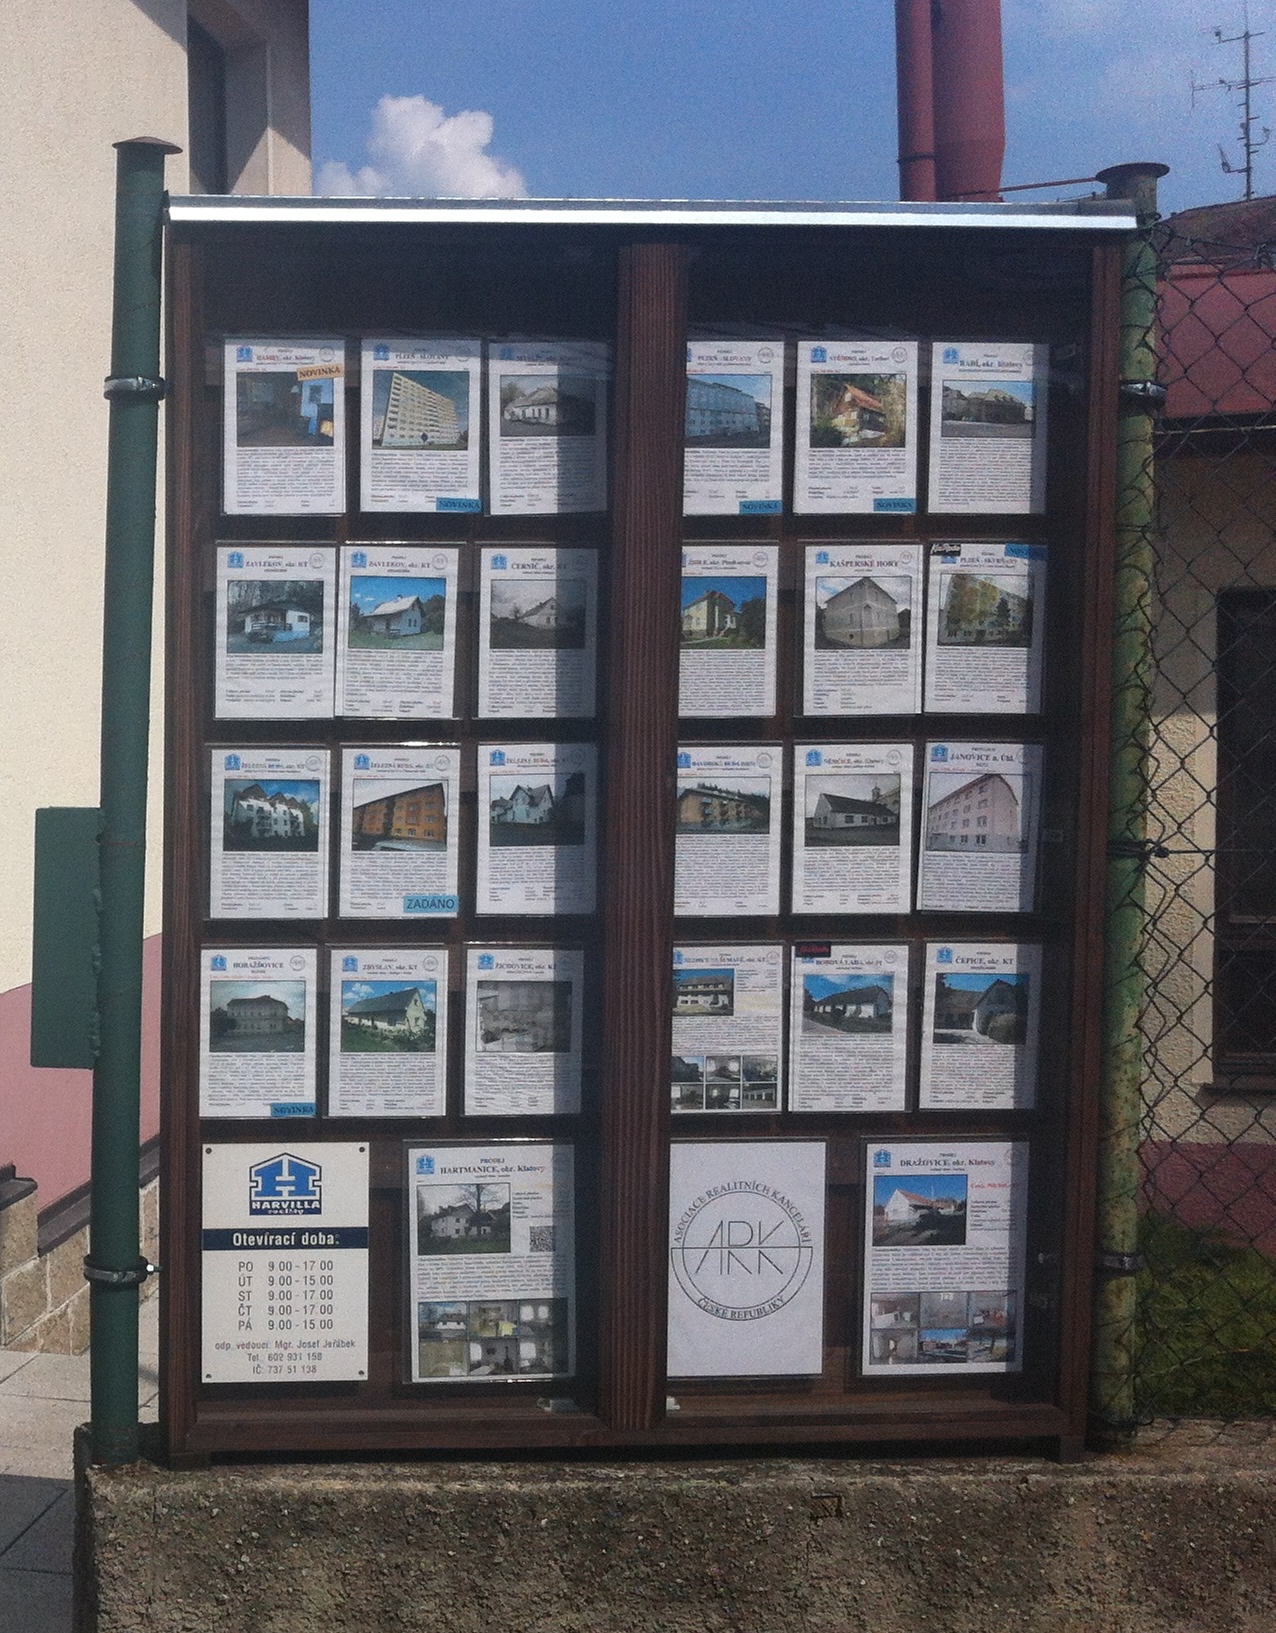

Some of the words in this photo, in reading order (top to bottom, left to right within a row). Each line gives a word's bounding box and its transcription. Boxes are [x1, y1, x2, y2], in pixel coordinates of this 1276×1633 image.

[298, 366, 341, 378] NOVINKA
[438, 500, 481, 509] NOVINKA
[829, 559, 875, 568] KAŠPERSKÉ
[273, 1106, 314, 1115] NOVINKA
[900, 1158, 950, 1167] DRAŽOVICE,
[952, 1159, 966, 1167] okr.
[440, 1166, 500, 1174] HARTMANICE,
[517, 1165, 545, 1174] Klatovy
[252, 1201, 320, 1209] HARVILLA
[674, 1196, 706, 1244] ASOCIACE
[705, 1180, 770, 1199] REALITNÍCH
[771, 1191, 811, 1243] KANCELÁŘÍ
[232, 1232, 296, 1246] Otevírací
[695, 1220, 784, 1275] ARK
[238, 1261, 254, 1272] PO
[238, 1274, 253, 1287] ÚT
[238, 1290, 253, 1302] ST
[238, 1303, 253, 1317] ČT
[697, 1297, 728, 1318] ČESKÉ
[730, 1295, 785, 1318] REPUBLIKY
[238, 1318, 253, 1331] PÁ
[296, 1339, 320, 1349] Josef
[267, 1353, 284, 1362] 602
[268, 1365, 282, 1374] 737
[287, 1365, 297, 1374] 51
